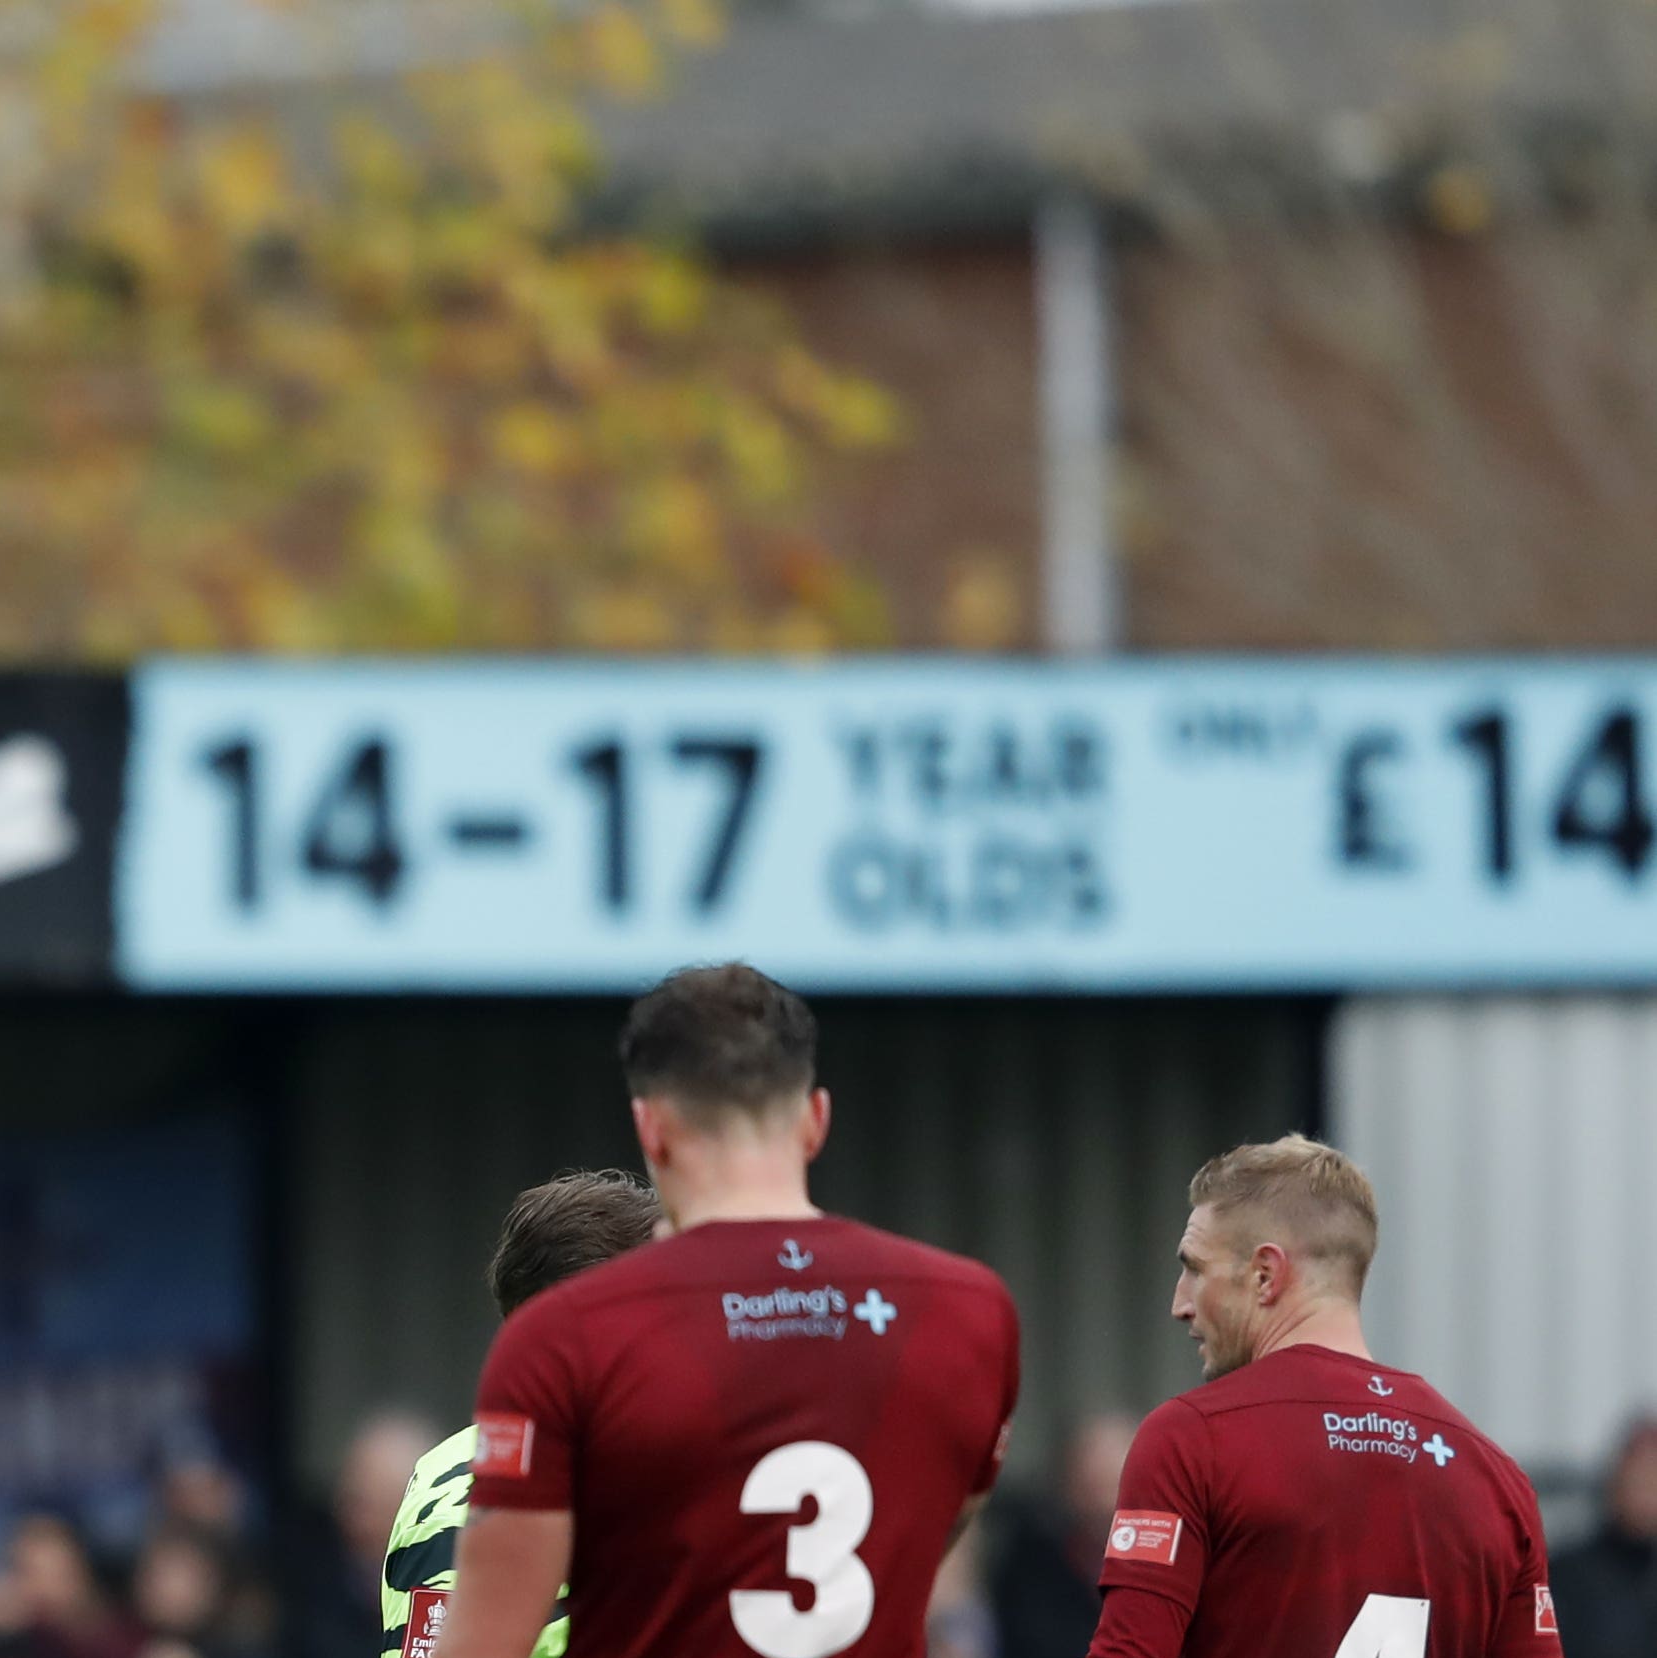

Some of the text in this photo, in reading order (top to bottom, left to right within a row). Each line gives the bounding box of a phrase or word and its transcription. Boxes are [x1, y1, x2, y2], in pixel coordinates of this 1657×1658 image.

[833, 708, 1113, 806] YEAR
[190, 722, 770, 920] 14-17
[823, 832, 1121, 936] OLDS
[721, 1284, 848, 1321] Darling's
[1322, 1412, 1417, 1441] Darling's
[1327, 1433, 1418, 1464] Pharmacy
